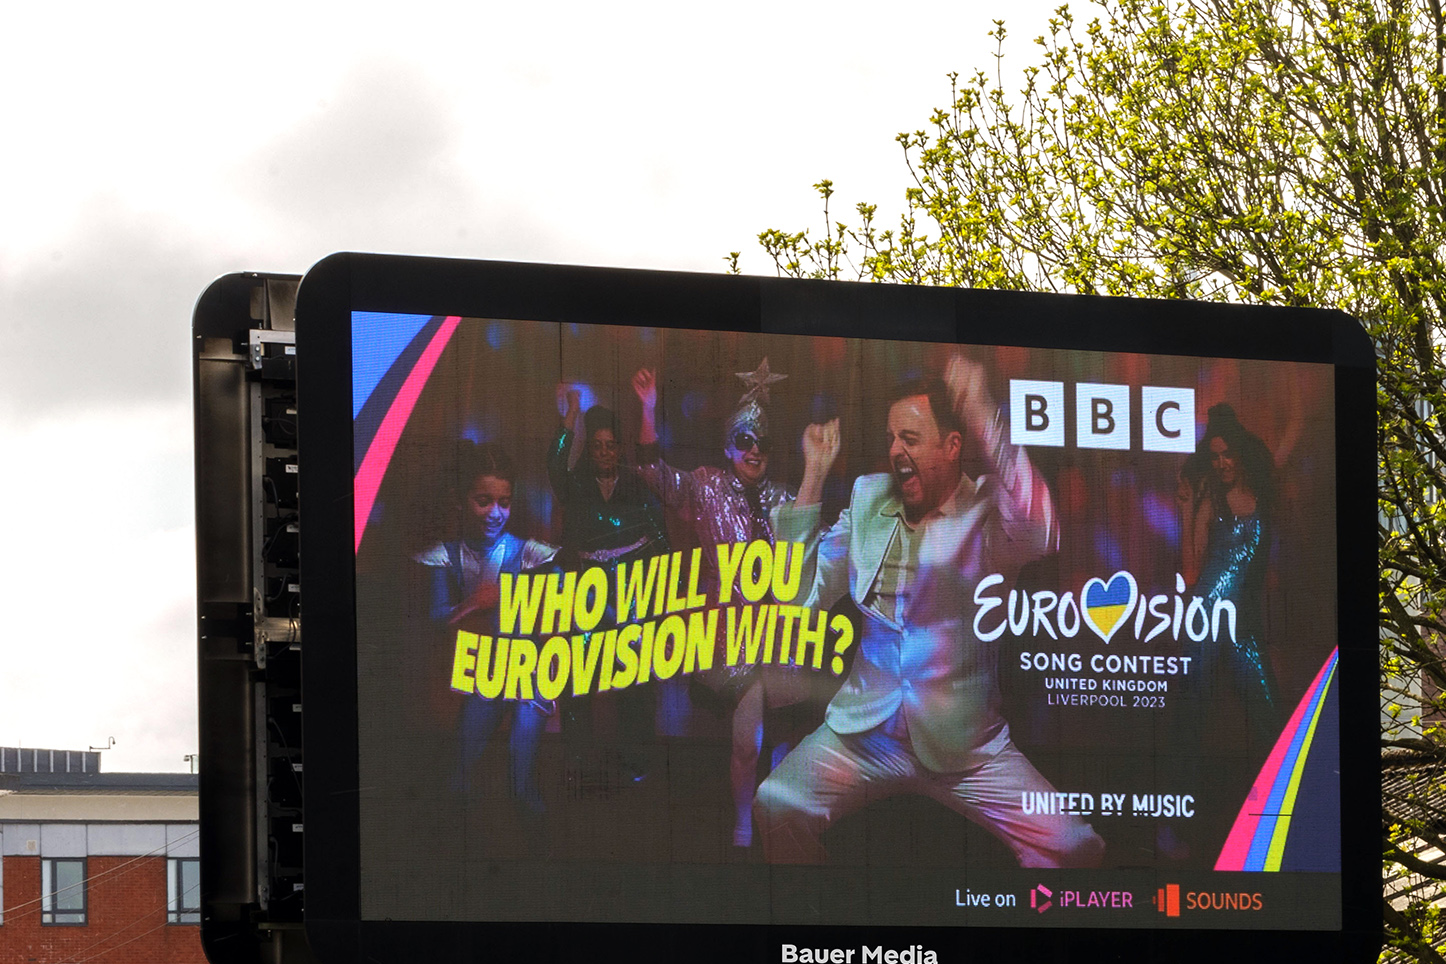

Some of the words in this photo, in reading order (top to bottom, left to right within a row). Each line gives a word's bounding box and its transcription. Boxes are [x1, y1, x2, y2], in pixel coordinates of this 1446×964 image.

[1022, 391, 1184, 441] BBC
[499, 565, 609, 635] WHO
[615, 547, 708, 625] WILL
[716, 539, 806, 604] YOU
[450, 606, 720, 700] EUROVISION
[726, 602, 855, 675] WITH?
[1020, 651, 1083, 673] SONG
[1090, 654, 1192, 675] CONTEST
[1045, 677, 1098, 691] UNITED
[1102, 678, 1168, 692] KINGDOM
[1047, 693, 1127, 707] LIVERPOOL
[1132, 695, 1166, 708] 2023
[1021, 791, 1094, 816] UNITED
[1101, 793, 1126, 816] BY
[1132, 794, 1195, 818] MUSIC
[955, 888, 991, 907] Live
[995, 893, 1016, 908] on
[1060, 890, 1133, 908] iPLAYER
[1186, 892, 1263, 911] SOUNDS
